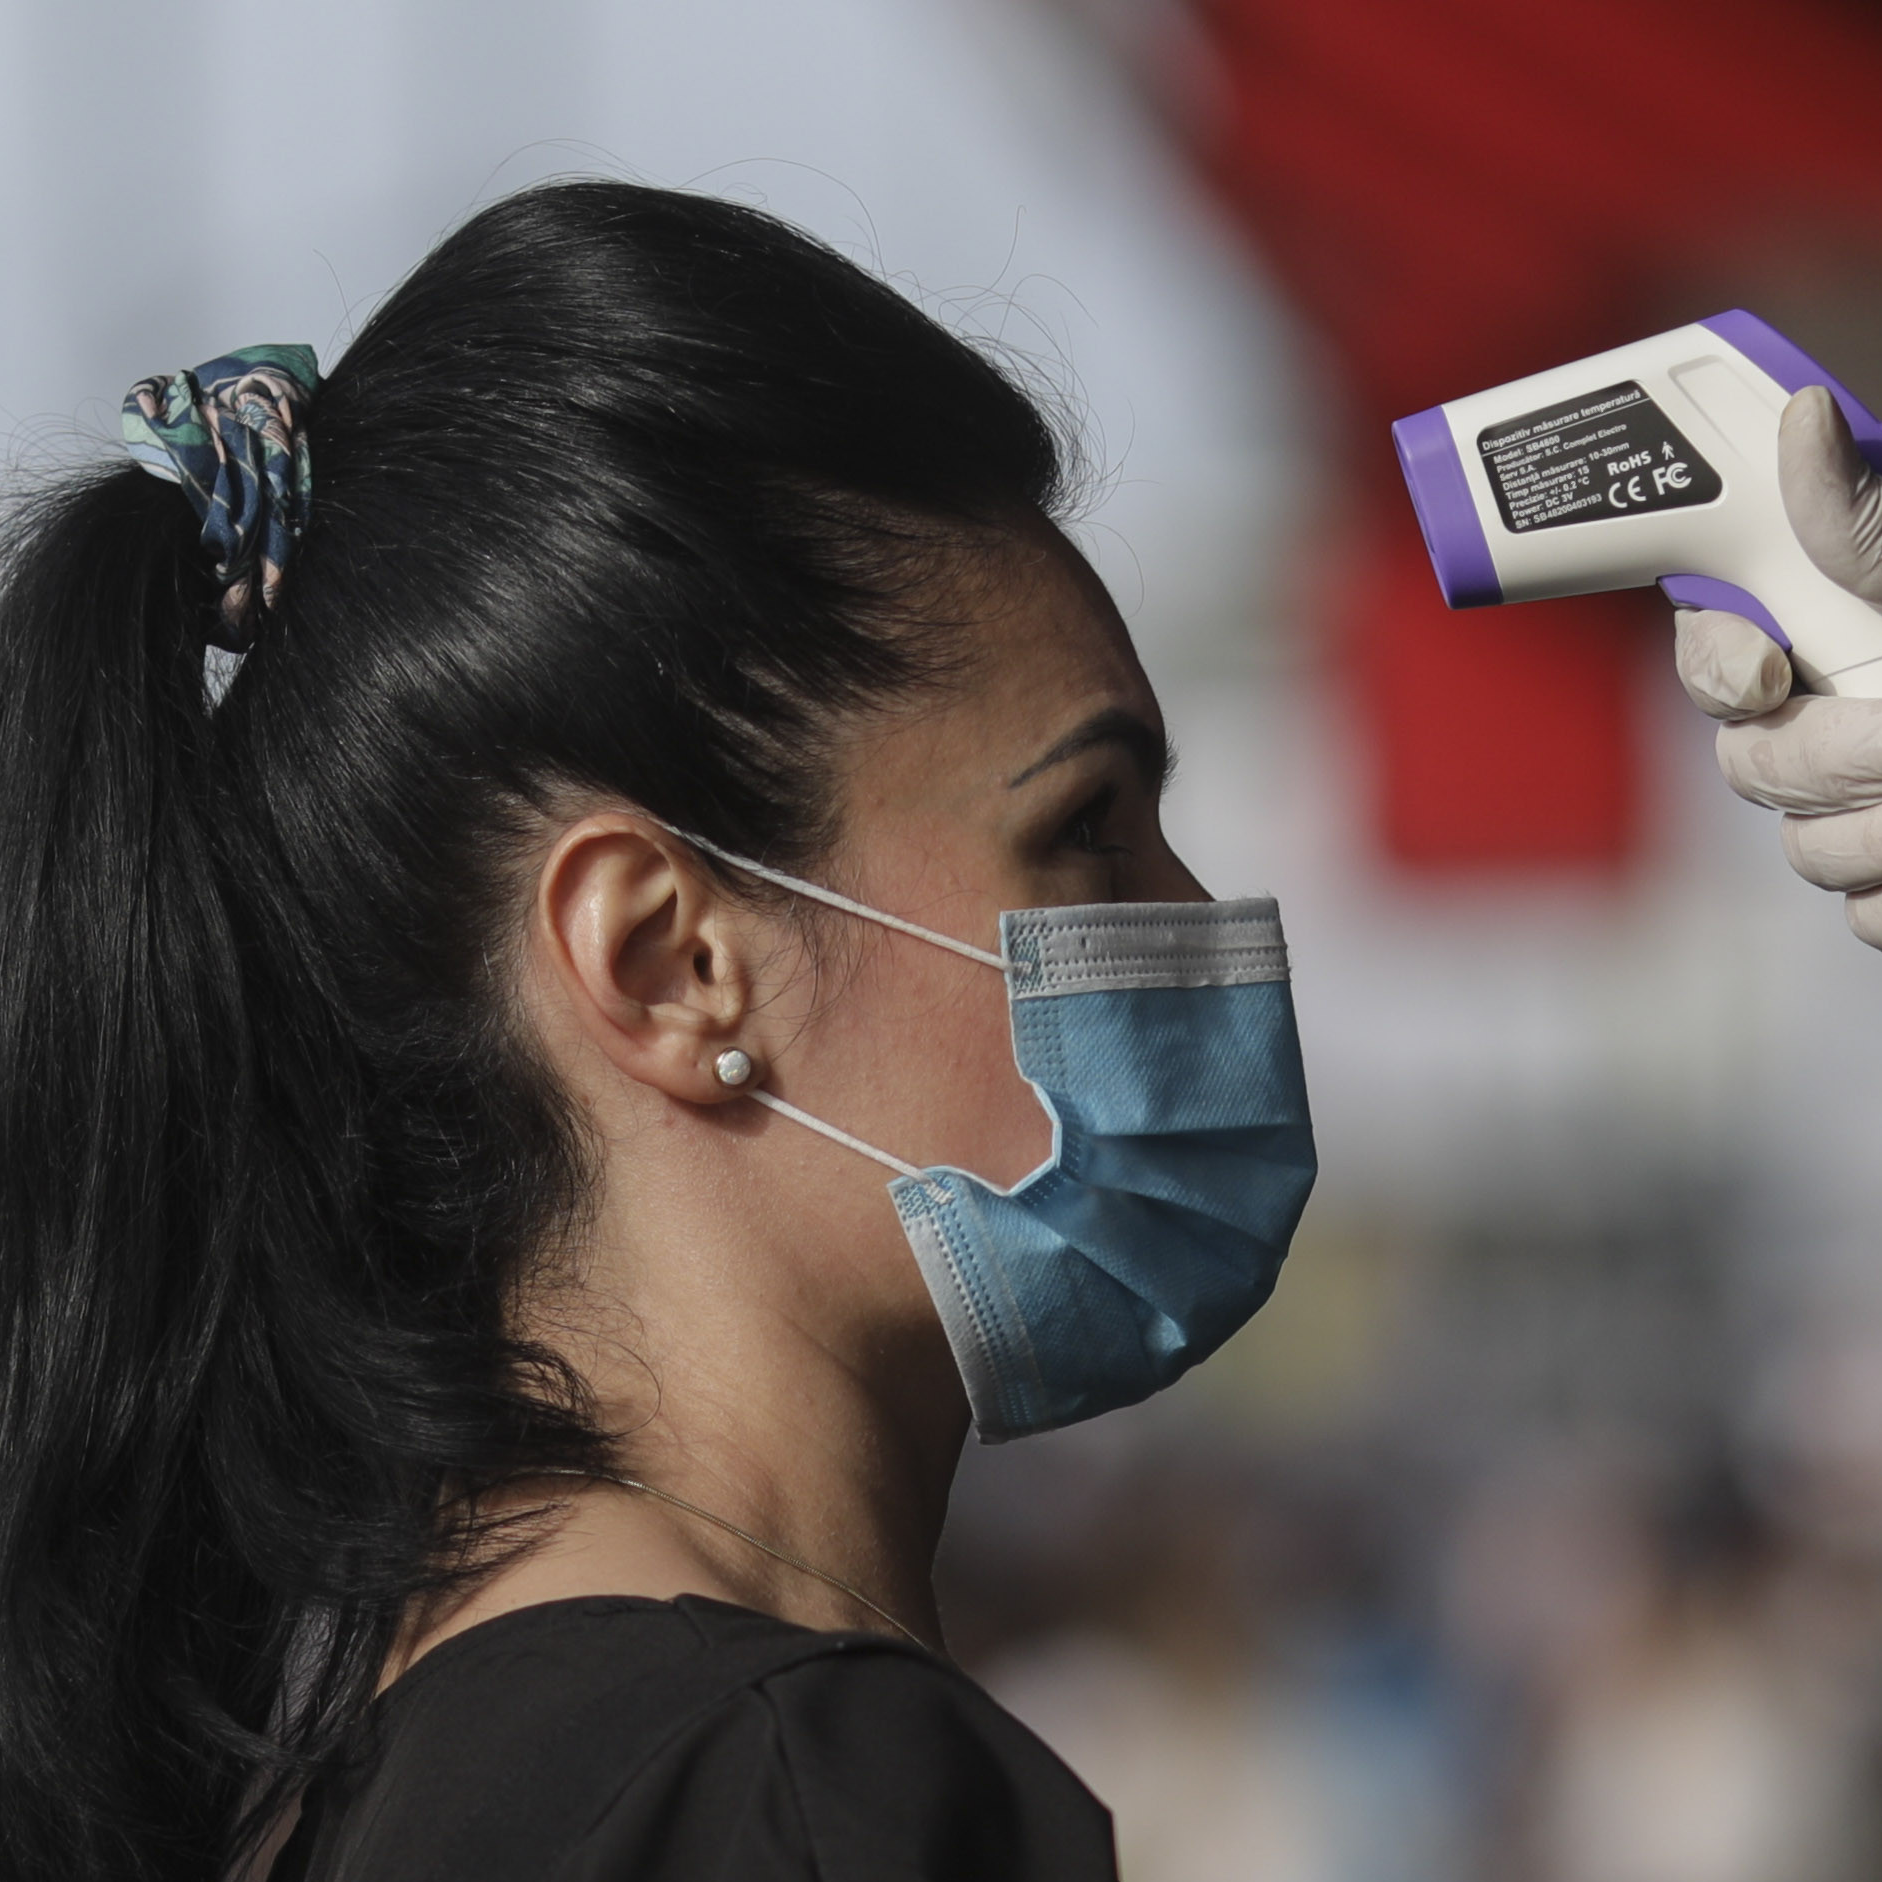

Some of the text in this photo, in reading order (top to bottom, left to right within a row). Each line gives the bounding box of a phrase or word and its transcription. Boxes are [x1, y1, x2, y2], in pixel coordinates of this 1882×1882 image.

[1482, 428, 1531, 450] Dispozitiv
[1563, 433, 1597, 450] Complet
[1597, 424, 1627, 439] Electro
[1493, 448, 1524, 464] Model:
[1607, 450, 1652, 476] RoHS
[1499, 470, 1518, 481] Serv
[1505, 488, 1529, 500] Timp
[1563, 481, 1577, 491] 0.2
[1608, 475, 1647, 508] CE
[1512, 492, 1573, 519] Power: DC 3V
[1515, 517, 1532, 529] SN:
